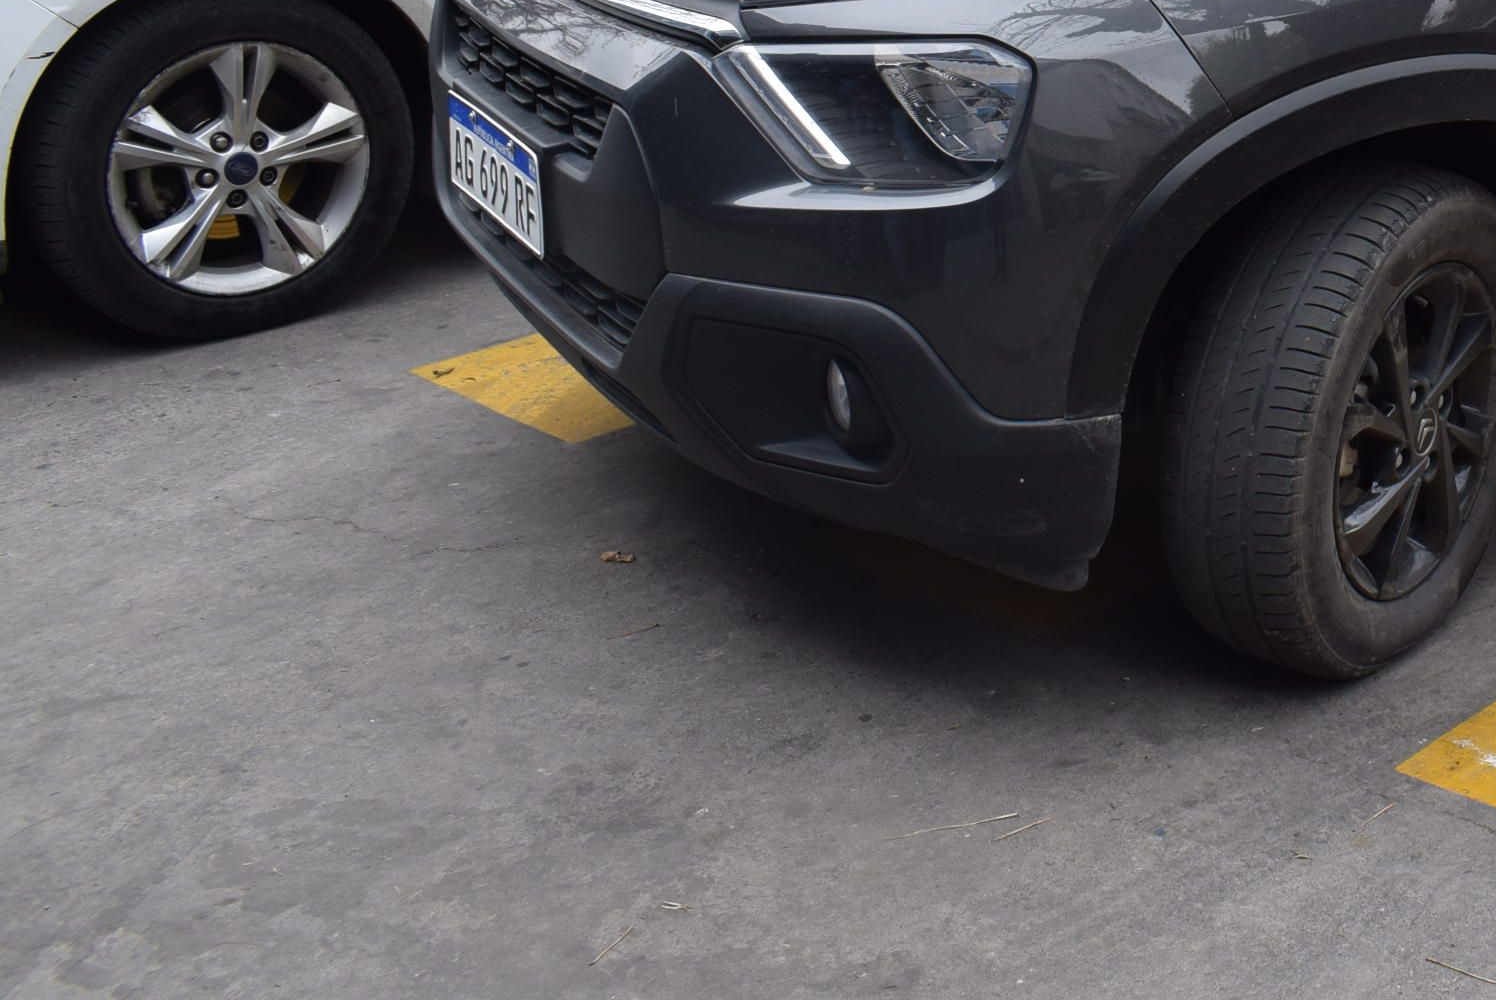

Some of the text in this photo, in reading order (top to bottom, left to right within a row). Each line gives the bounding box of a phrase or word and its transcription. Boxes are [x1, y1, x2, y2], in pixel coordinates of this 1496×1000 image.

[455, 127, 536, 237] AG 699 RF
